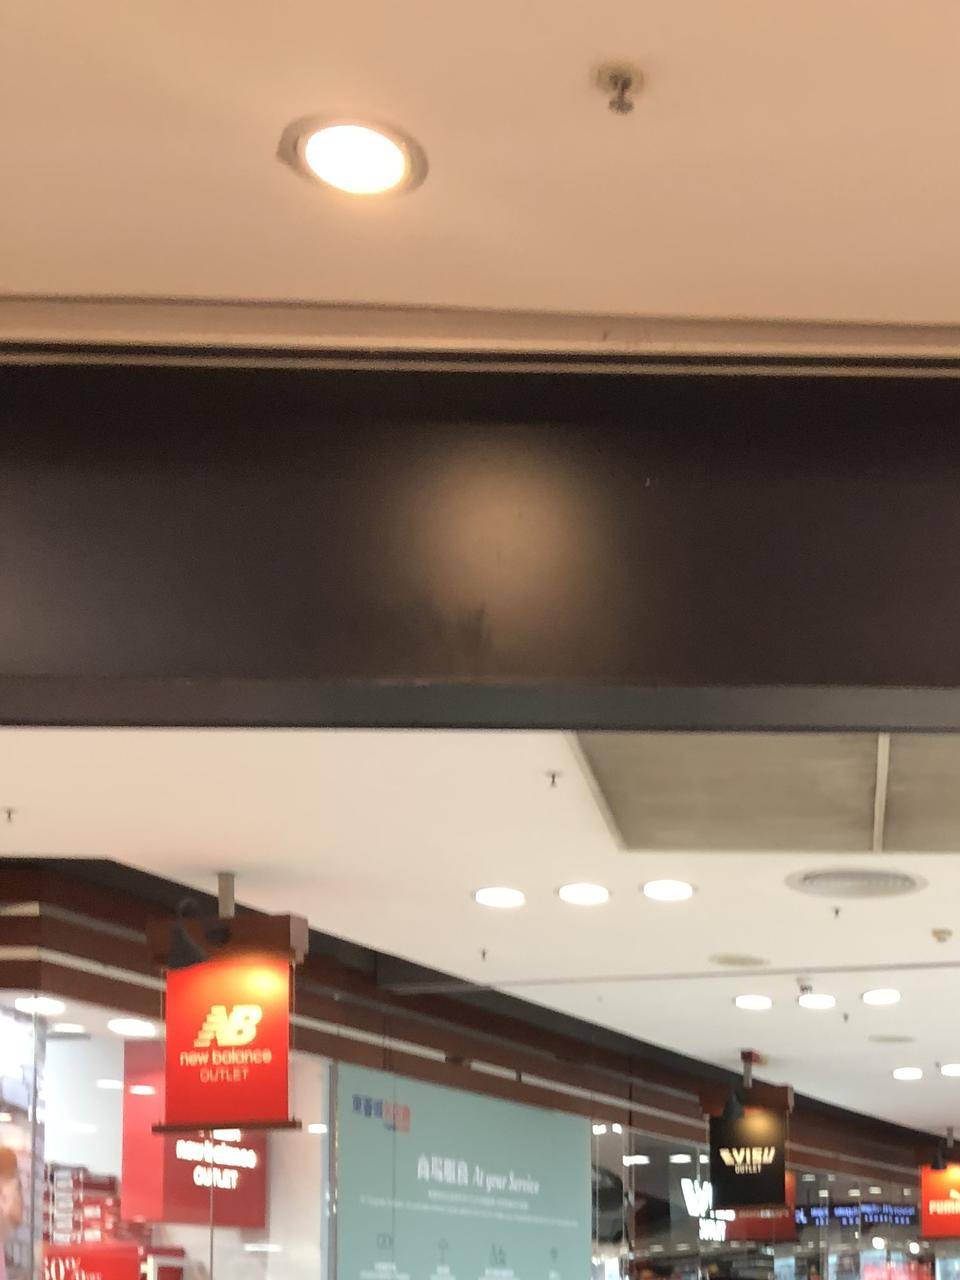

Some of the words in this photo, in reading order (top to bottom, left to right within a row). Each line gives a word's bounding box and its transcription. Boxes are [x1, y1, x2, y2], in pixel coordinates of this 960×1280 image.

[180, 1051, 208, 1066] new
[212, 1048, 272, 1065] balance
[200, 1067, 249, 1083] OUTLET
